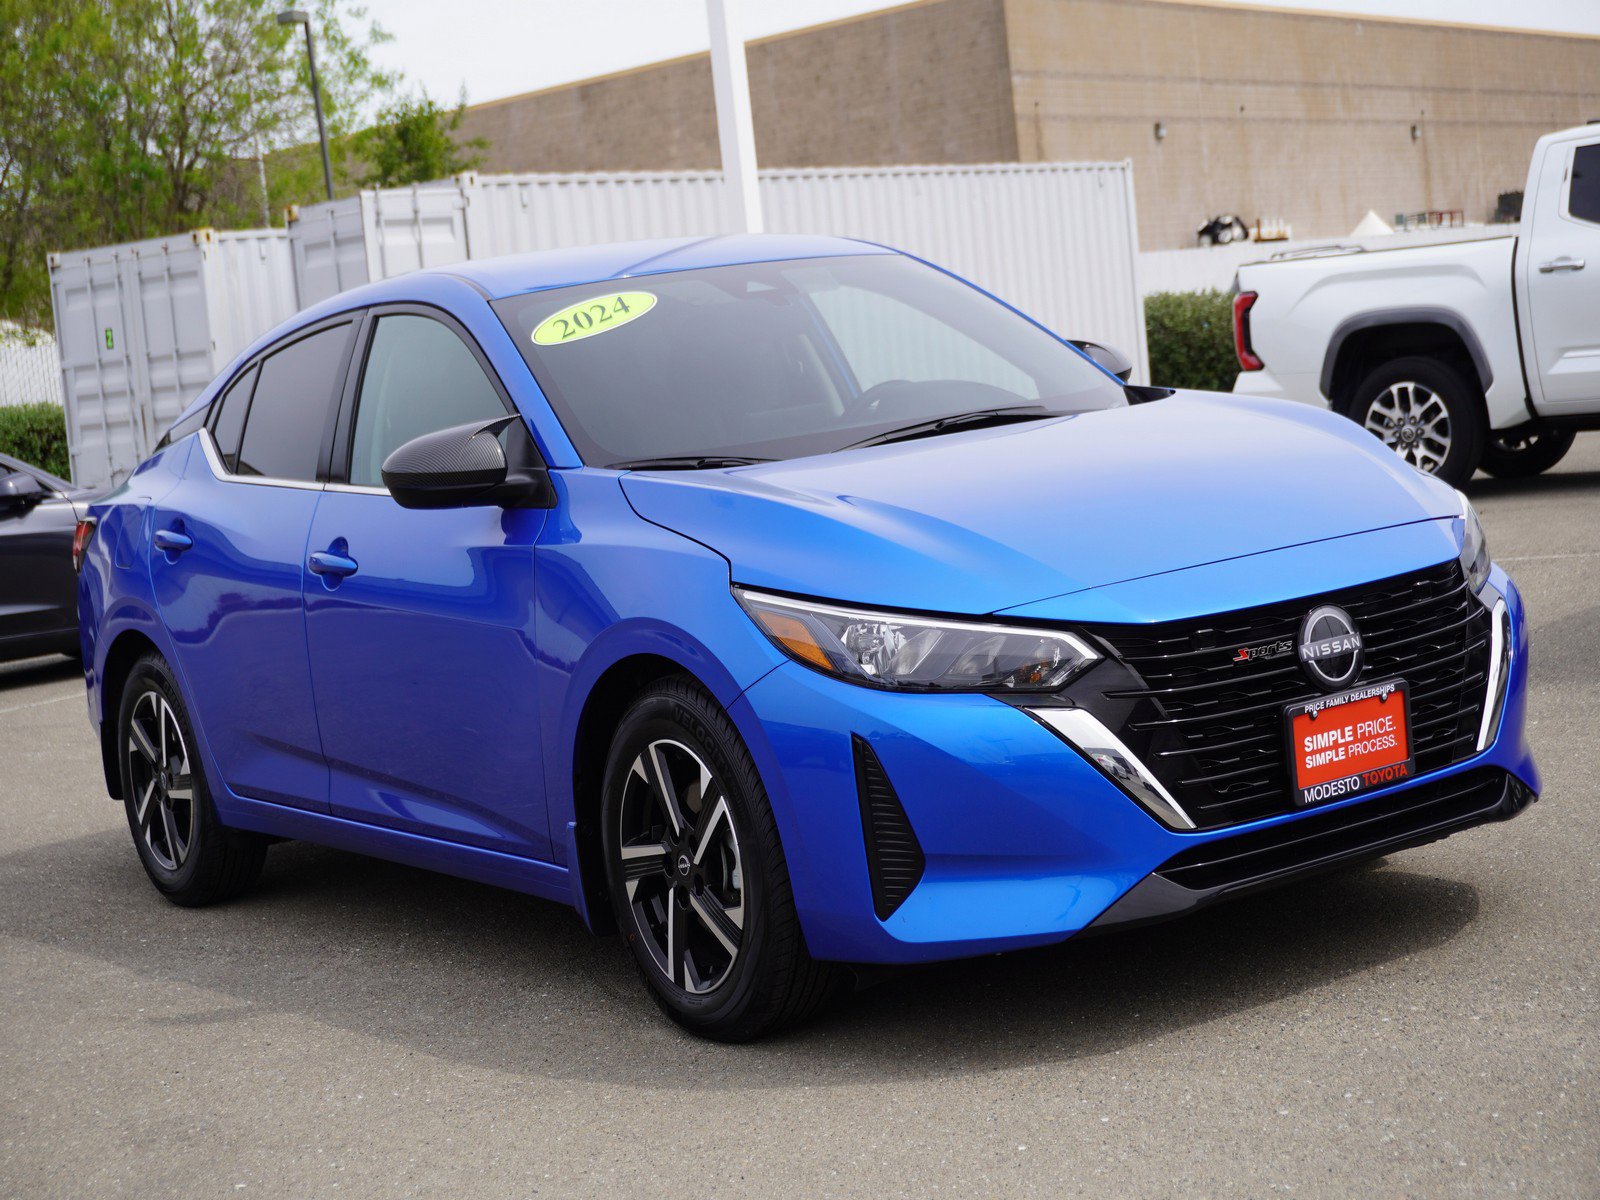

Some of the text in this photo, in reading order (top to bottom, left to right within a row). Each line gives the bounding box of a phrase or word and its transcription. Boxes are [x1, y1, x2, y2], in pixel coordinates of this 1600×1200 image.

[552, 296, 630, 339] 2024
[1233, 640, 1293, 661] Sports
[1302, 636, 1361, 659] NISSAN
[1304, 684, 1395, 713] PRICE FAMILY DEALERSHIPS
[1304, 716, 1397, 752] SIMPLE PRICE.
[1305, 734, 1398, 769] SIMPLE PROCESS.
[1304, 764, 1408, 803] MODESTO TOYOTA
